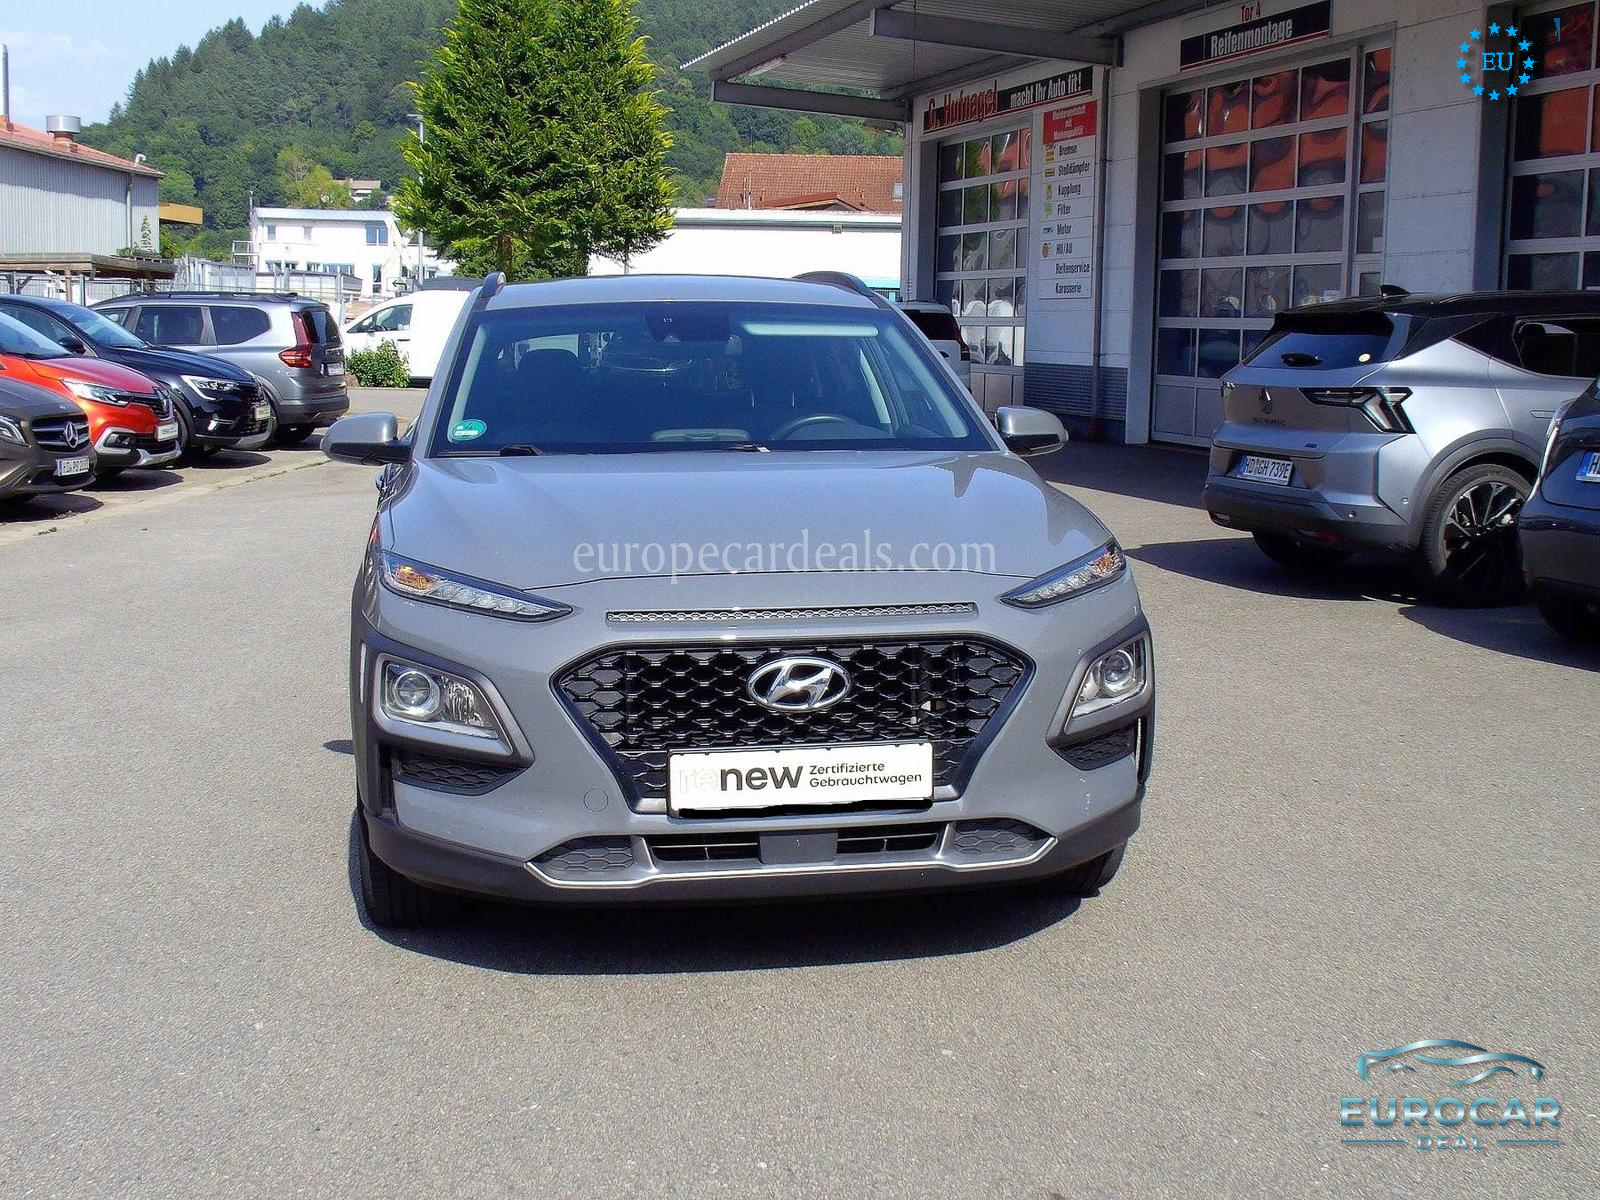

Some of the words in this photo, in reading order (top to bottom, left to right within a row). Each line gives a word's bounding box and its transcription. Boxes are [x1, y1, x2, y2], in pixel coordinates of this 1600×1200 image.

[1240, 4, 1253, 23] Tor
[1255, 1, 1262, 18] 4
[1210, 18, 1293, 58] Reifenmontage
[1010, 85, 1034, 108] macht
[1035, 82, 1047, 102] Ihr
[1047, 78, 1066, 99] Auto
[1067, 71, 1082, 94] fit!
[1058, 145, 1078, 156] Bremse
[1057, 183, 1081, 198] Kupplung
[1057, 203, 1071, 216] Filter
[1056, 223, 1072, 235] Motor
[1055, 261, 1090, 275] Reifenservice
[1055, 282, 1082, 295] Karosserie
[809, 761, 886, 775] Zertifizierte
[809, 773, 922, 789] Gebrauchtwagen
